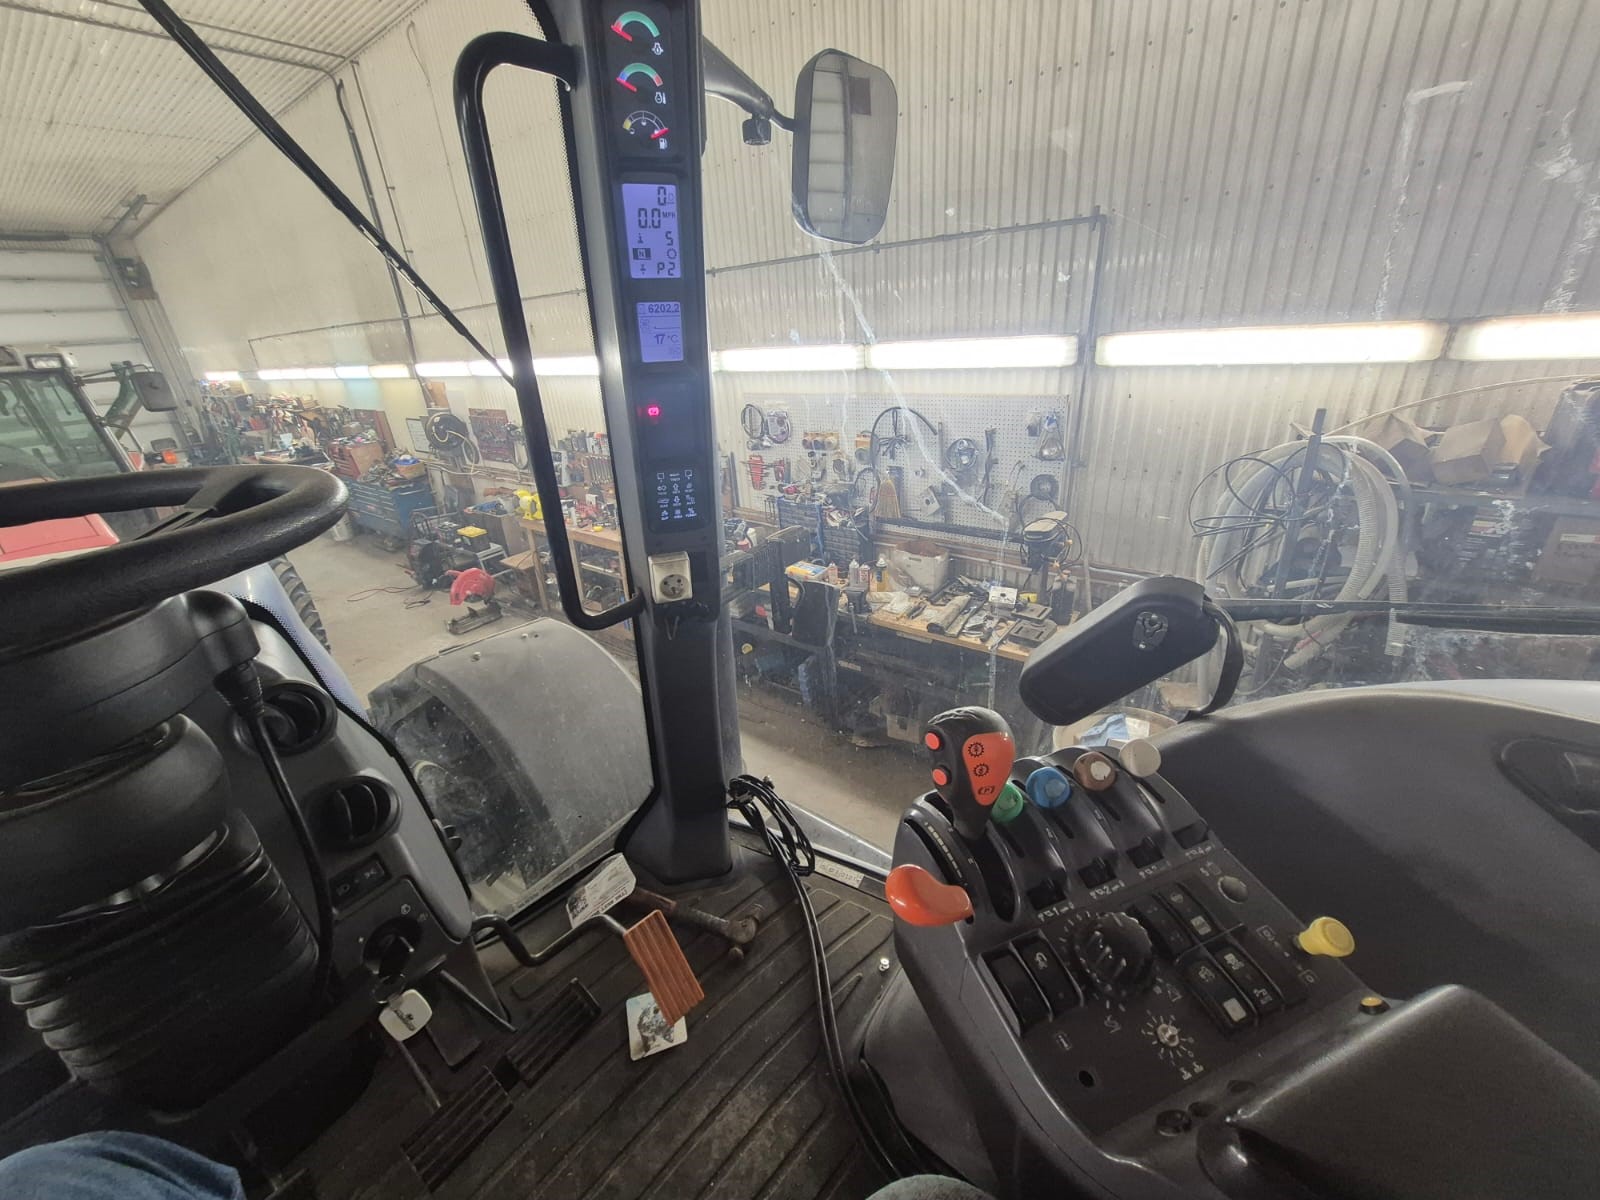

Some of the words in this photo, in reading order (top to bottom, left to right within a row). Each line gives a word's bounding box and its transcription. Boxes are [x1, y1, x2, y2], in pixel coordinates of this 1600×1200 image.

[657, 186, 666, 206] 0
[638, 208, 661, 229] 0.0
[657, 262, 676, 276] P2
[647, 303, 680, 313] 6202.2
